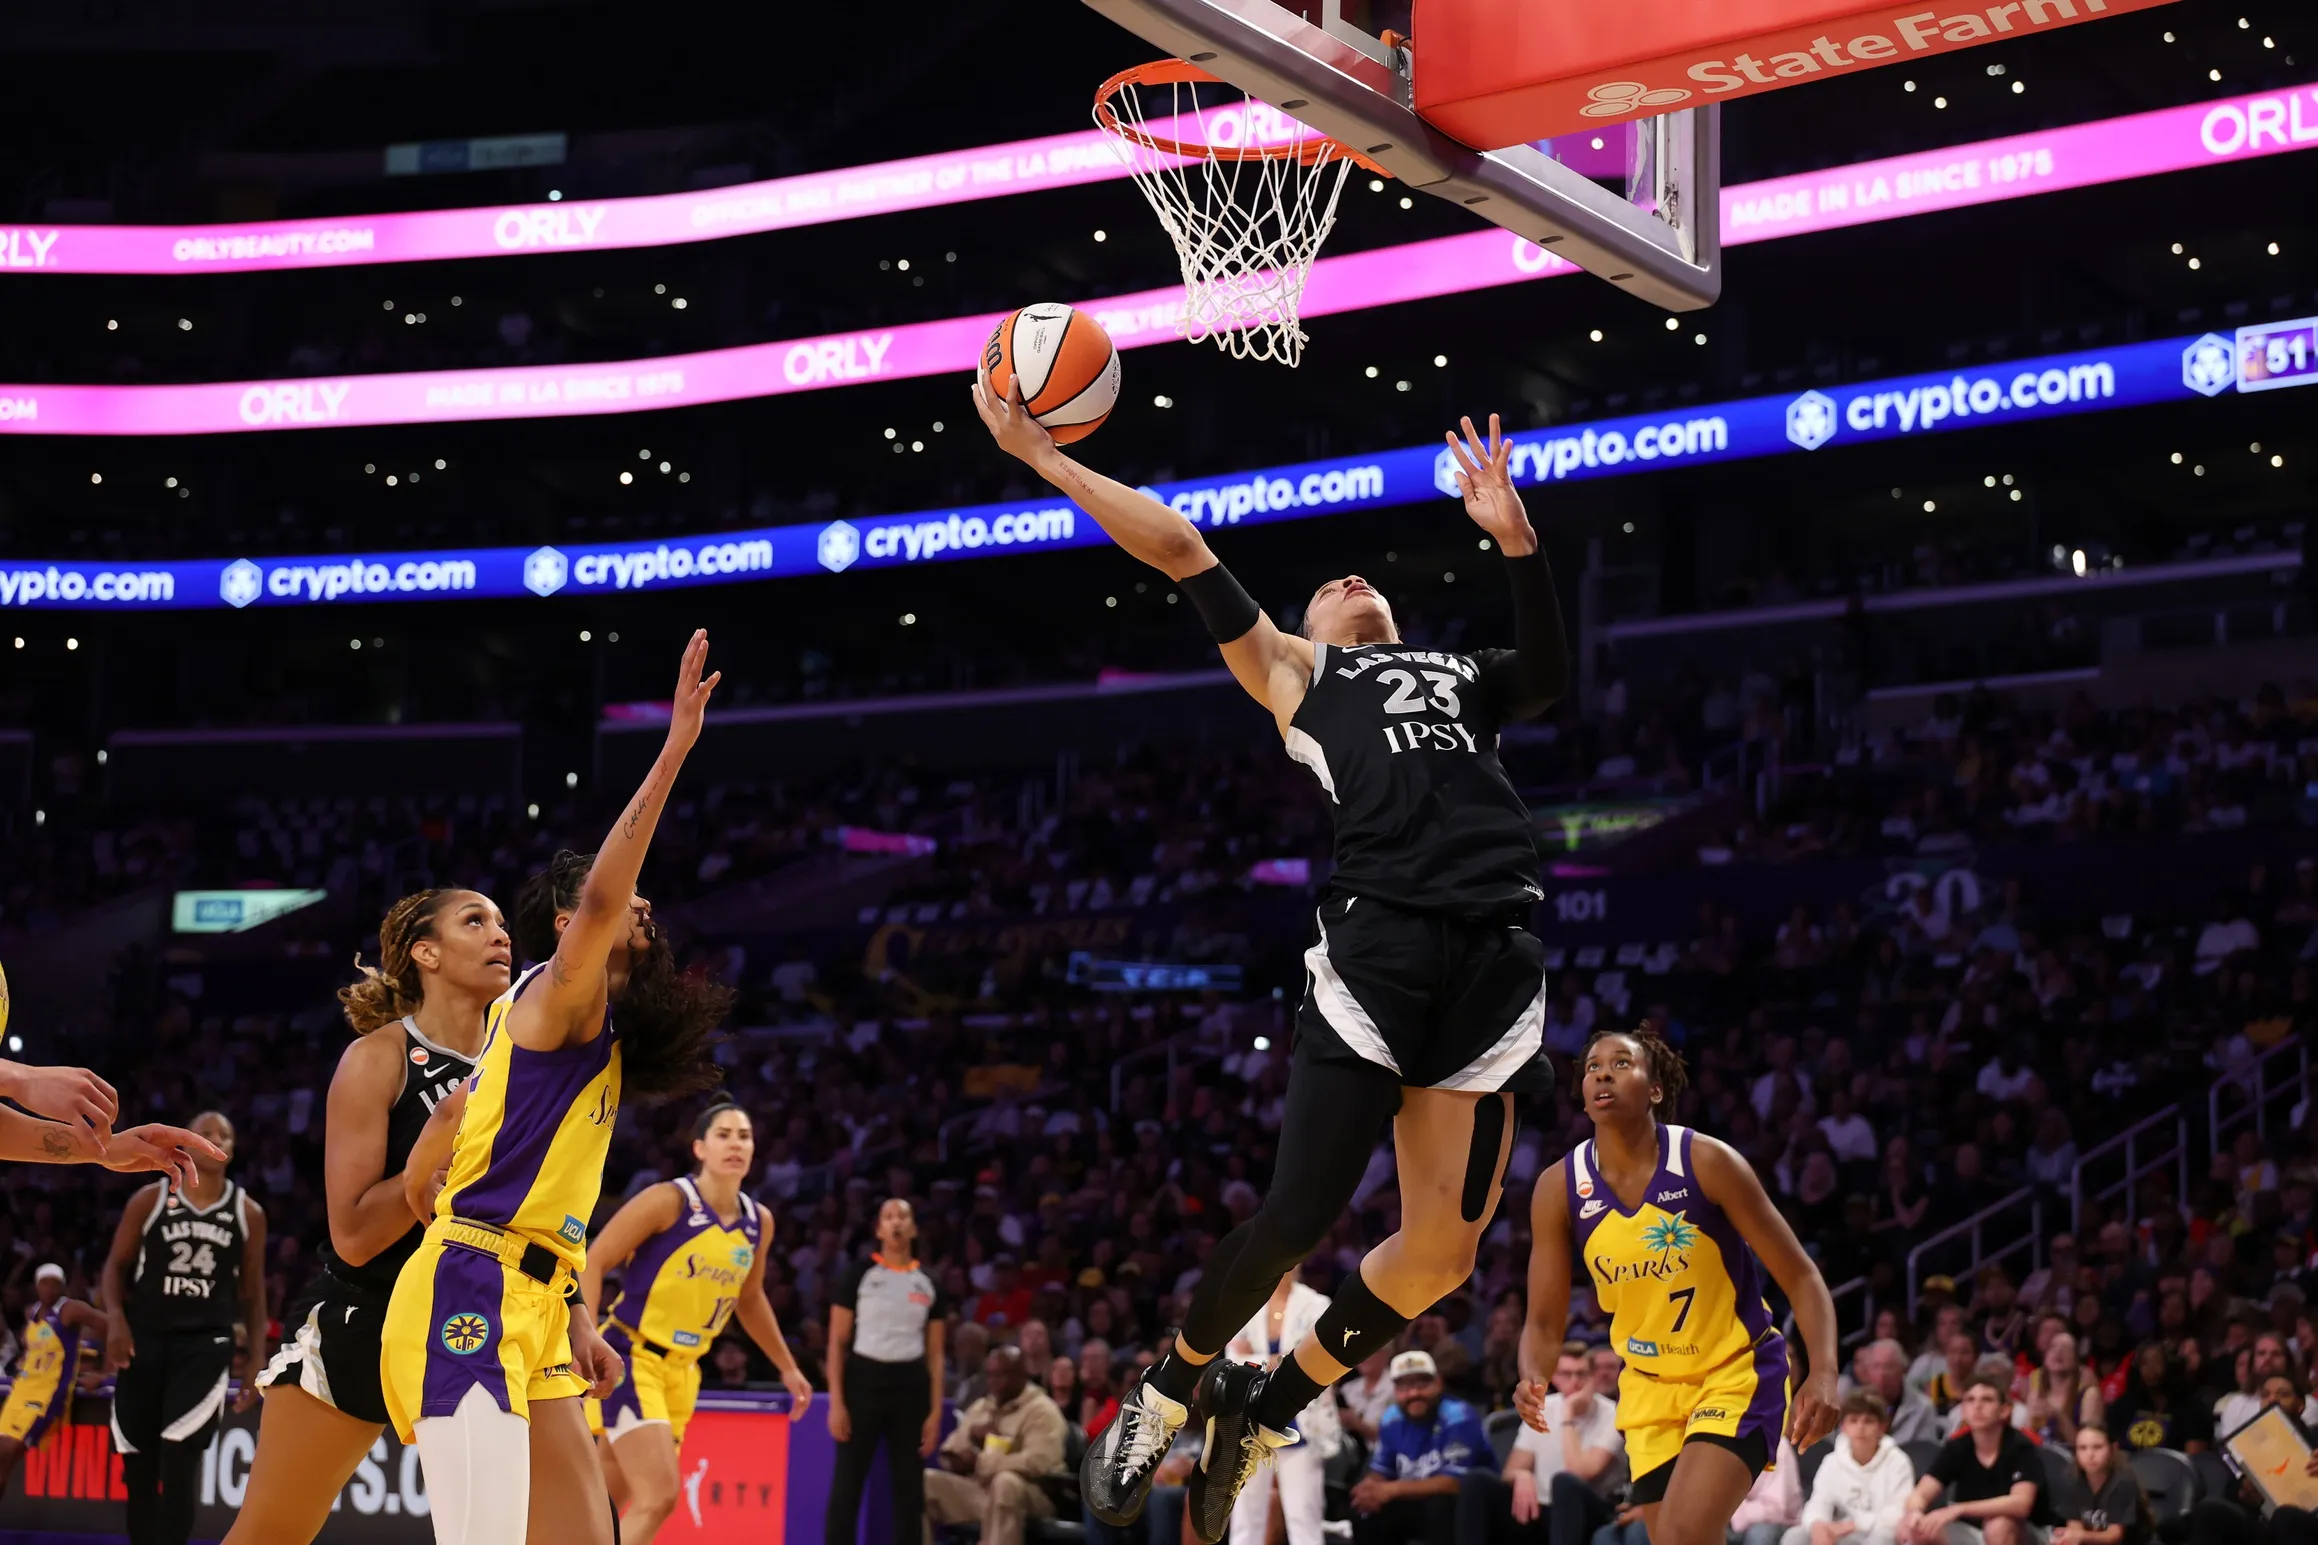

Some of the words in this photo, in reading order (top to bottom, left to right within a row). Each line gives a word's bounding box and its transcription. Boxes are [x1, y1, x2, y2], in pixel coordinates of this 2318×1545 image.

[2199, 89, 2318, 156] ORL
[934, 163, 967, 192] OF
[970, 155, 1014, 185] THE
[1016, 152, 1047, 180] LA
[1729, 189, 1812, 228] MADE
[1817, 184, 1849, 213] IN
[1855, 176, 1892, 207] LA
[1895, 159, 1982, 200] SINCE
[1988, 148, 2054, 184] 1975
[172, 227, 375, 262] ORLYBEAUTY.COM
[493, 204, 608, 250] ORLY
[782, 332, 895, 386] ORLY
[2266, 334, 2307, 374] 51
[238, 381, 351, 426] ORLY
[425, 382, 494, 408] MADE
[499, 382, 526, 405] IN
[529, 379, 561, 404] LA
[563, 375, 632, 402] SINCE
[1846, 361, 2115, 431] crypto.com
[1509, 416, 1728, 481] rypto.com
[1170, 465, 1384, 526] crypto.com
[864, 507, 1075, 561] crypto.com
[268, 560, 476, 601] crypto.com
[573, 540, 773, 589] crypto.com
[1335, 652, 1394, 680] LAS
[1391, 651, 1476, 684] VEGAS
[1375, 668, 1461, 719] 23
[1382, 721, 1478, 754] IPSY
[1552, 888, 1608, 922] 101
[1656, 1186, 1689, 1204] Albert
[563, 1221, 583, 1241] UCLA
[167, 1240, 217, 1277] 24
[162, 1275, 217, 1299] IPSY
[1668, 1286, 1696, 1334] 7
[1629, 1340, 1655, 1356] UCLA
[1660, 1342, 1700, 1356] Health
